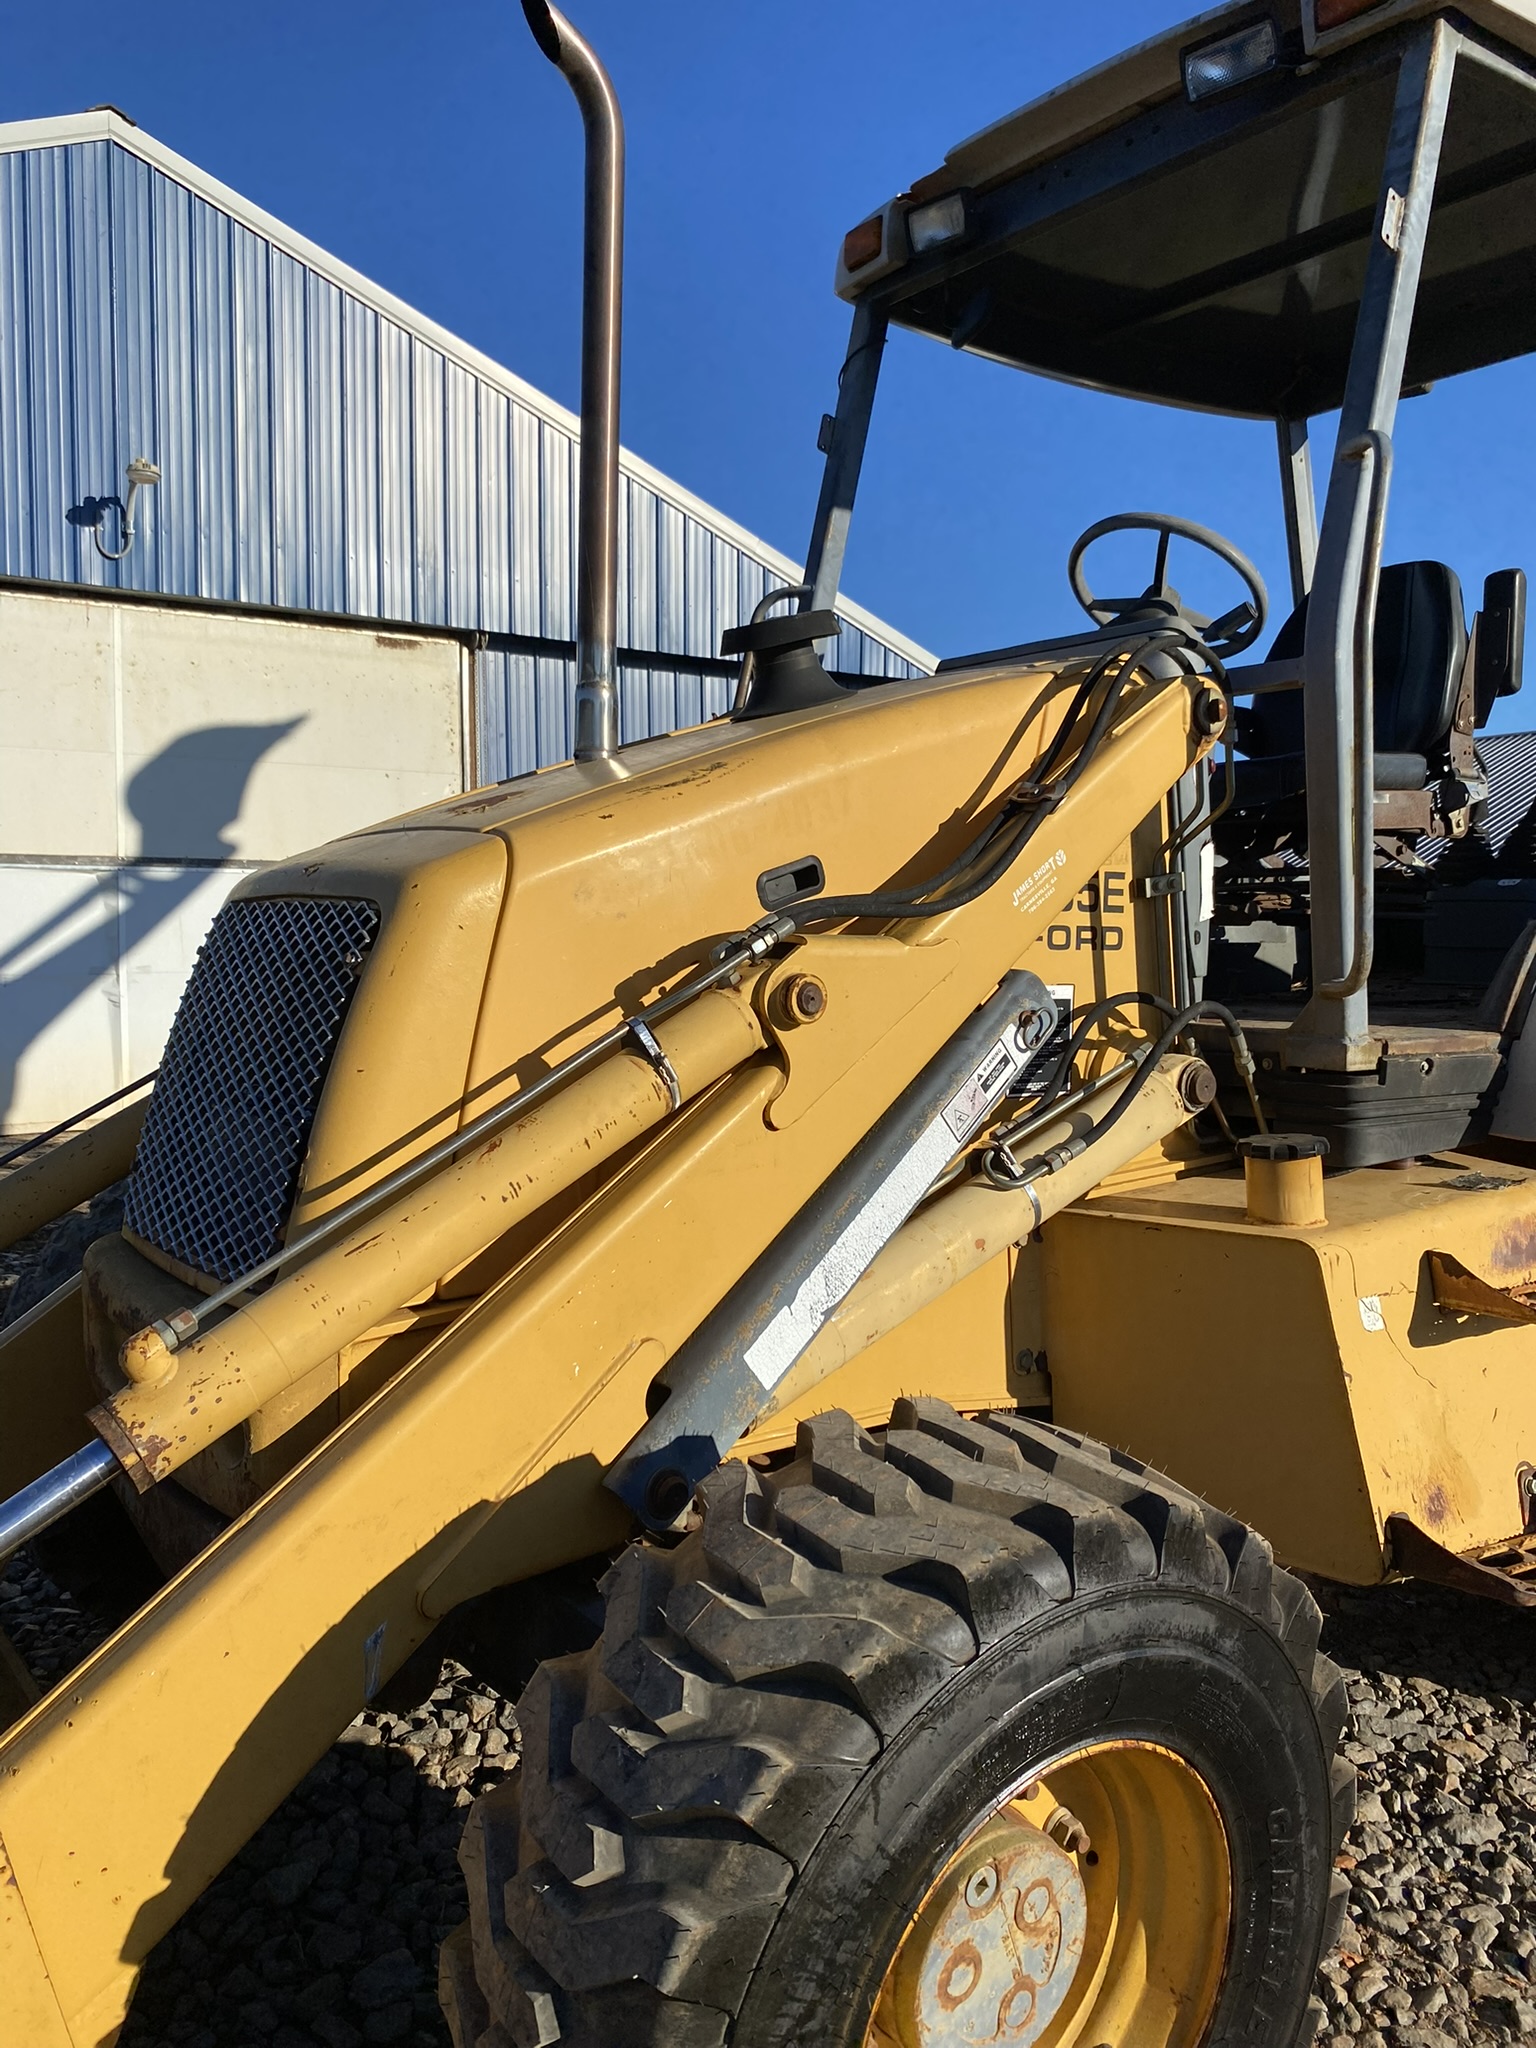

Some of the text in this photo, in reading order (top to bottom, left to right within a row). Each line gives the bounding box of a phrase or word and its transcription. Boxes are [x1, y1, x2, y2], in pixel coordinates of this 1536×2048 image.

[1012, 856, 1056, 907] JAMES SHORT
[1036, 925, 1124, 951] ORD
[982, 1047, 1003, 1072] WARNING
